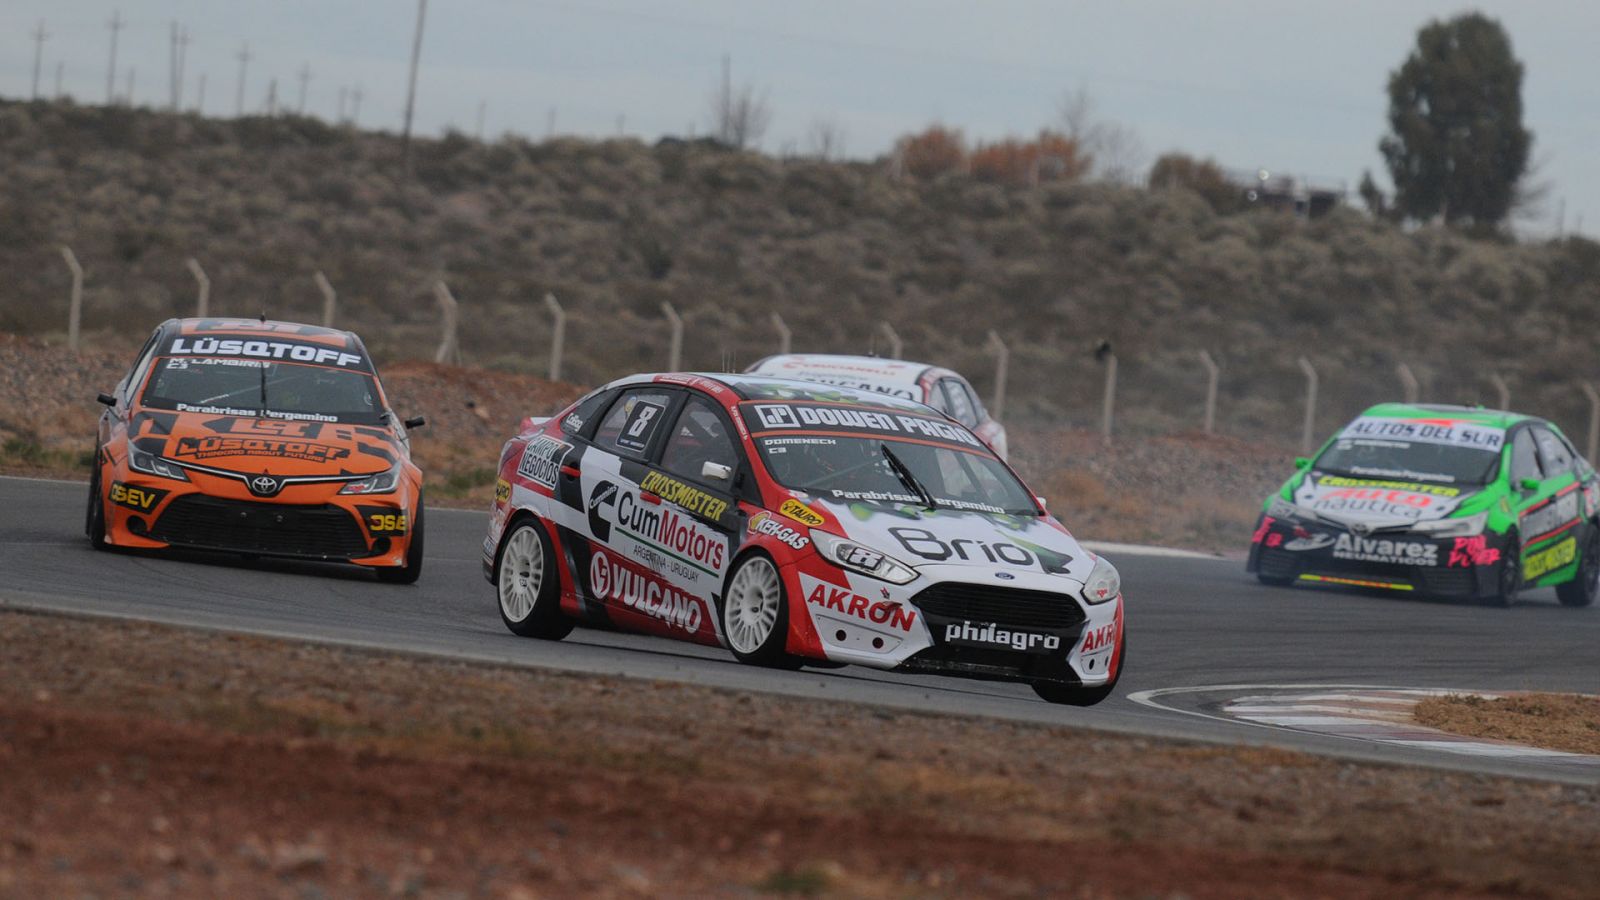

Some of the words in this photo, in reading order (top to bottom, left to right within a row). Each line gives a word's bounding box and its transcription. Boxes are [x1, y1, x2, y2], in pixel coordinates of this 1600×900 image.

[169, 337, 362, 367] LÜSQTOFF
[176, 403, 256, 417] Parabrisas
[627, 406, 659, 437] 8
[796, 406, 899, 432] DOWEN
[896, 415, 980, 448] PAGIO
[1353, 422, 1414, 437] AUTOS
[1419, 424, 1454, 440] DEL
[1461, 429, 1500, 447] SUR
[178, 437, 345, 459] LÜSQTOFF
[519, 452, 559, 484] NEGOCIOS
[641, 470, 728, 521] CROSSMASTER
[832, 489, 921, 503] Parabrisas
[926, 497, 1005, 515] ergamino
[791, 503, 822, 525] TAURO
[617, 490, 725, 570] CumMotors
[1334, 532, 1439, 558] Alvarez
[887, 526, 1036, 566] Brio
[612, 563, 703, 634] VULCANO
[807, 582, 917, 632] AKRON
[944, 621, 1060, 650] philagro
